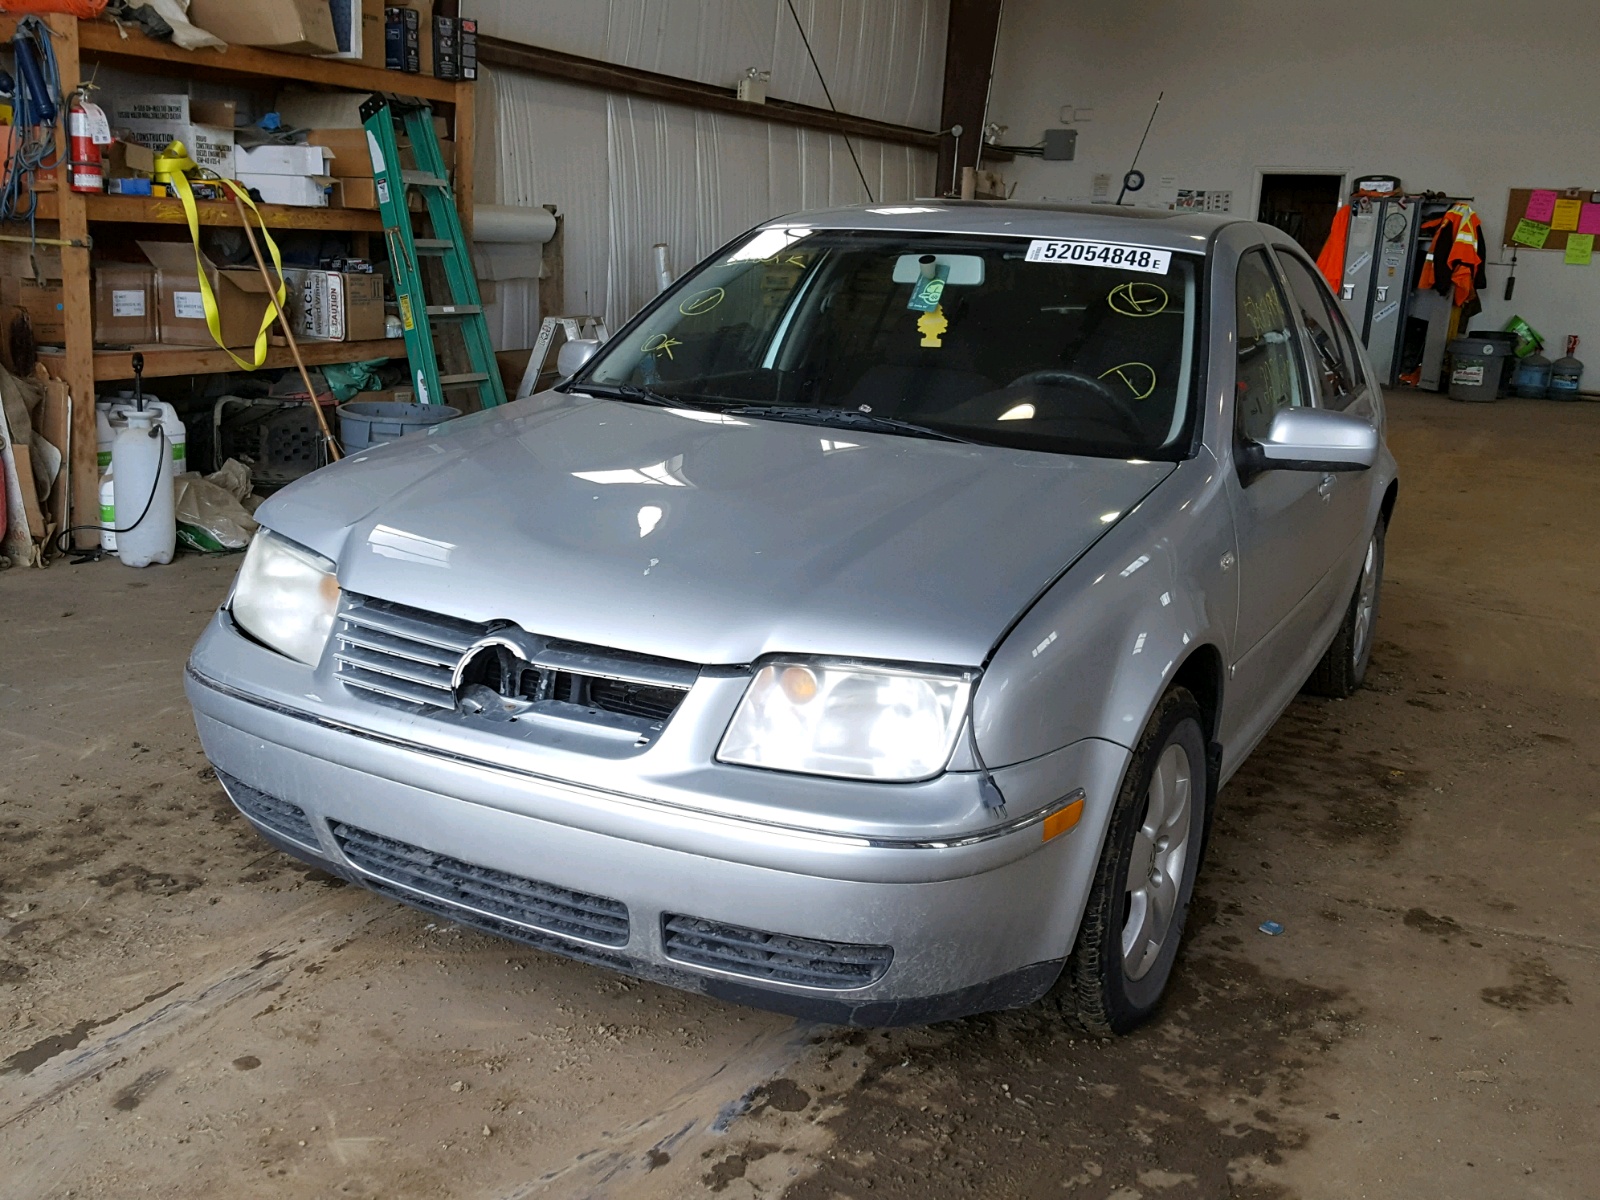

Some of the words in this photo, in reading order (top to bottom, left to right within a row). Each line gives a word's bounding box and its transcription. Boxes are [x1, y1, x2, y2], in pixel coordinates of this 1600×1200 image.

[136, 133, 174, 142] CONSTRUCTION
[1044, 243, 1151, 268] 52054848
[1152, 259, 1162, 270] E
[330, 287, 338, 326] CAUTION
